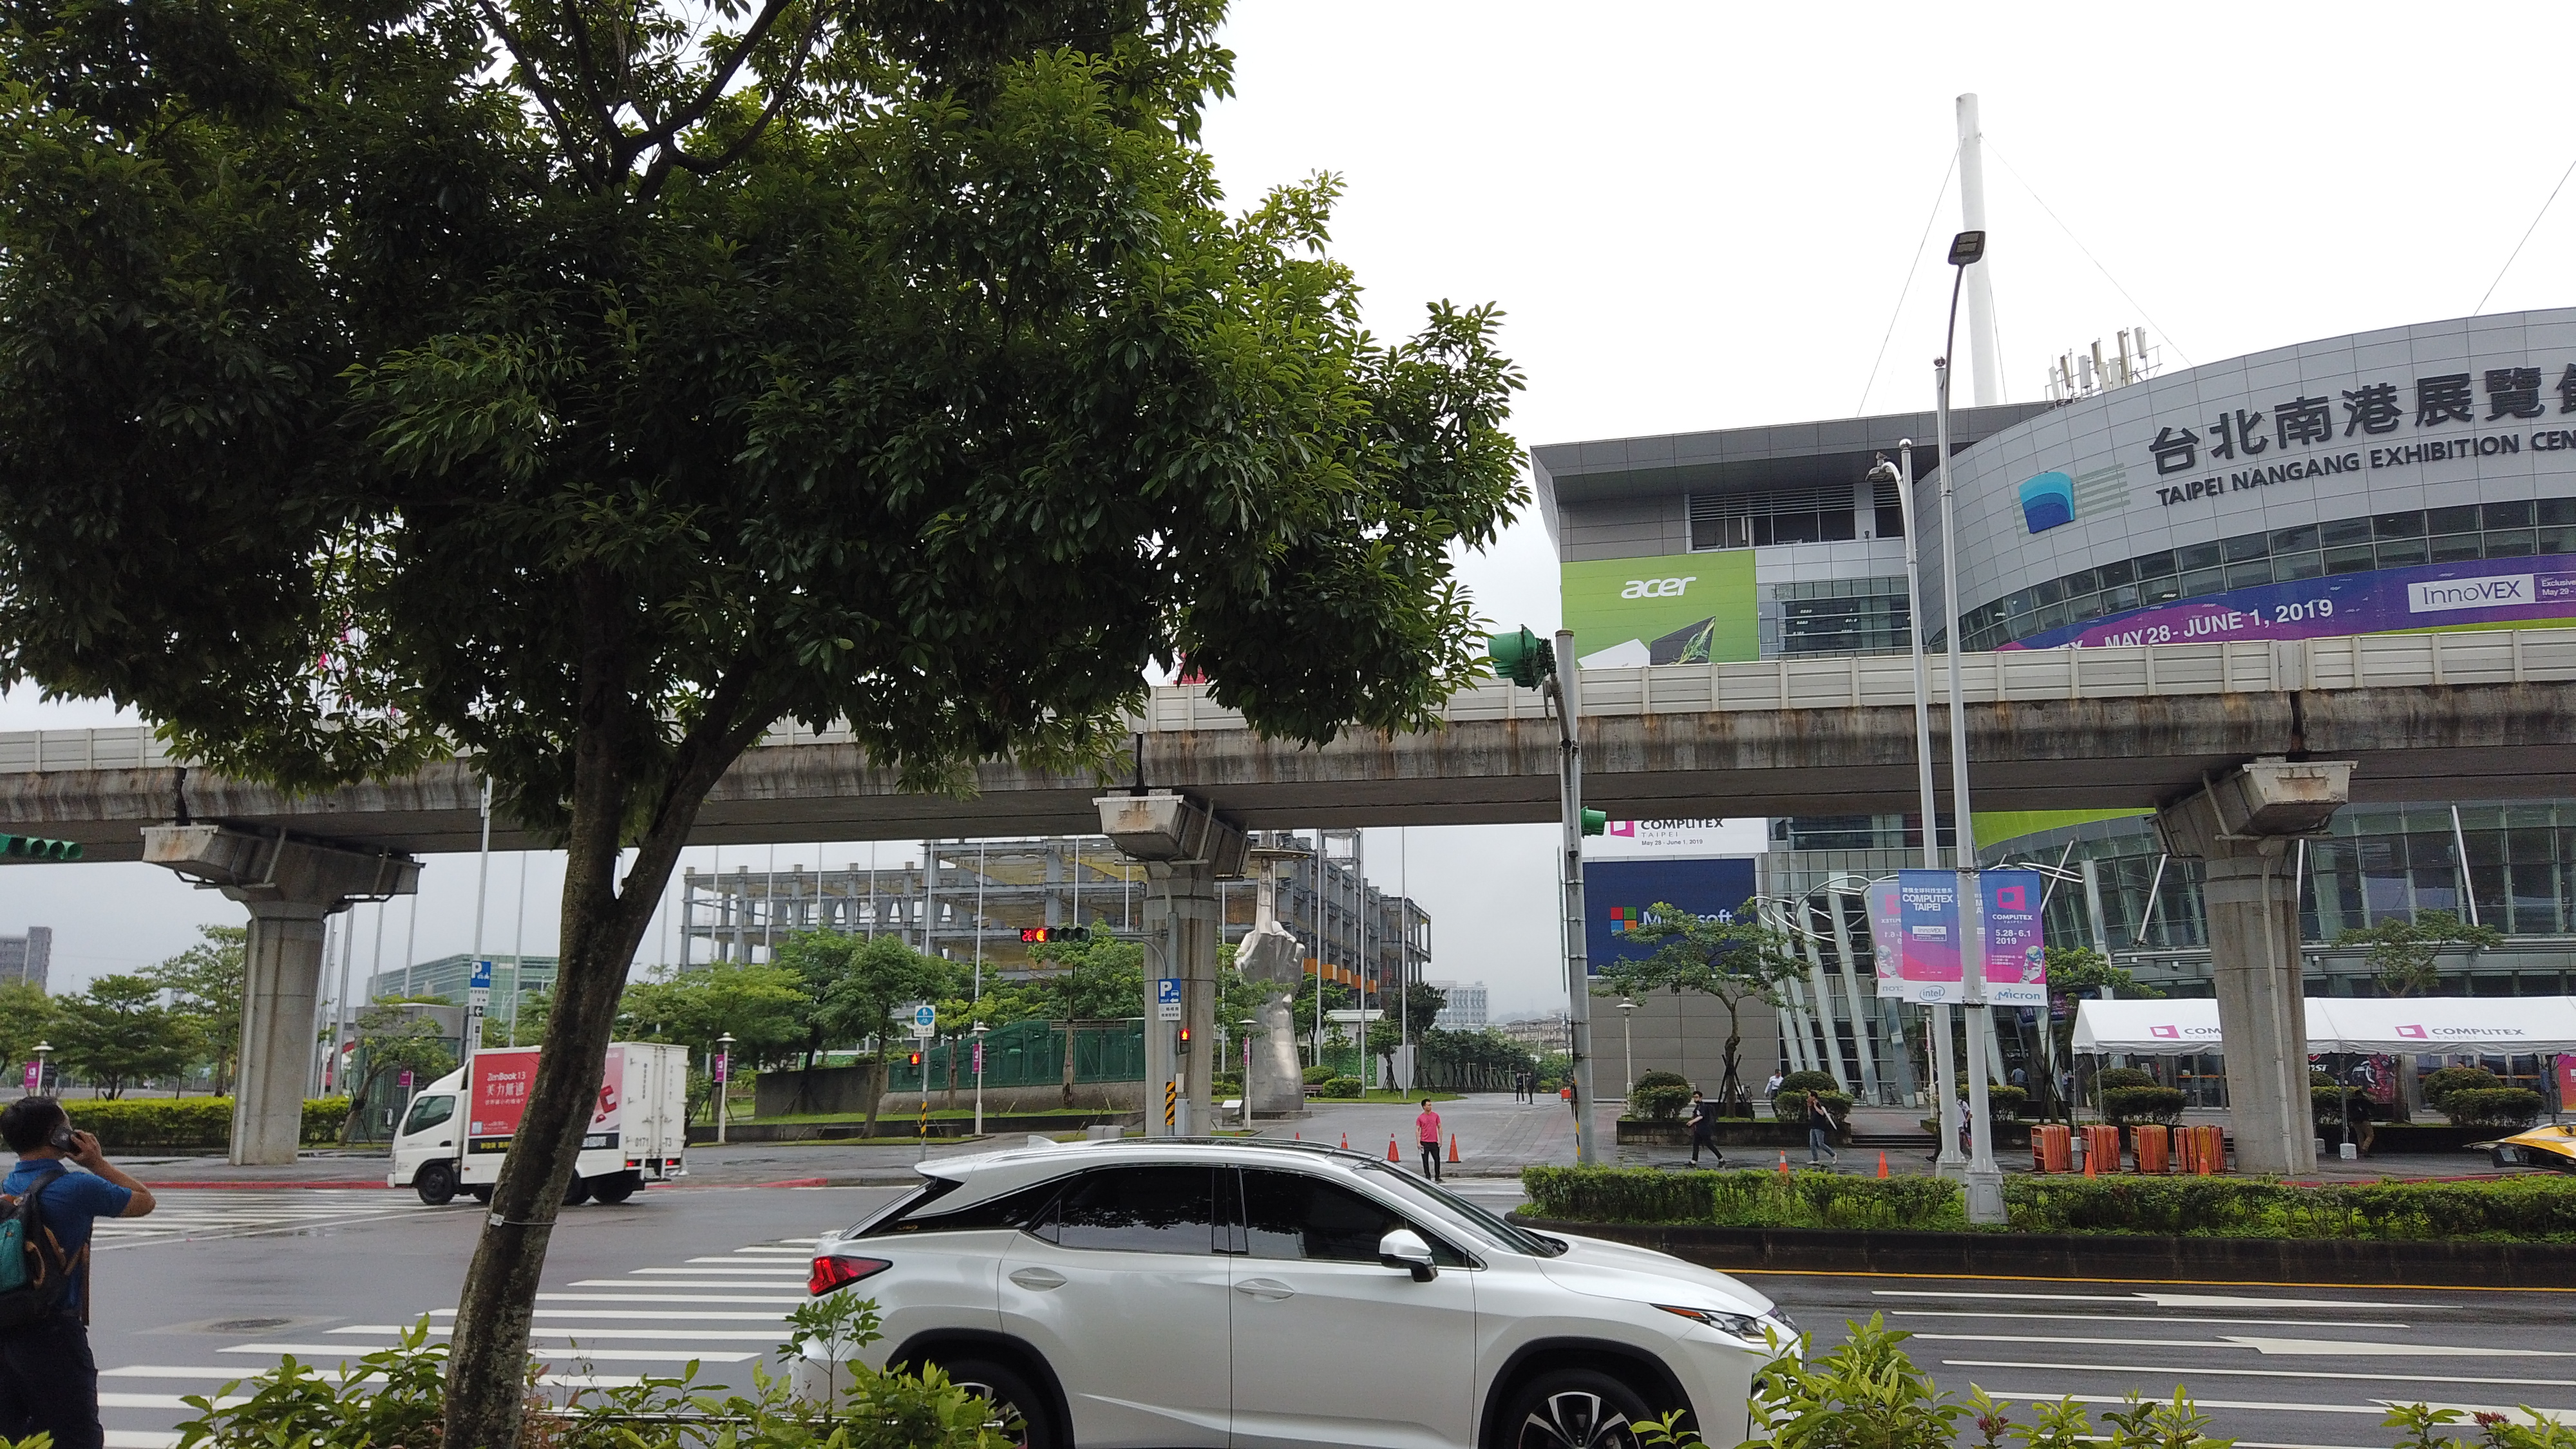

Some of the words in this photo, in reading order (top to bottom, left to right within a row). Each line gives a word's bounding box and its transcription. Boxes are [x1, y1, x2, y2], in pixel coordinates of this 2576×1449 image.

[2156, 477, 2224, 506] TAIPEI
[2233, 453, 2359, 491] NANGANG
[2371, 433, 2520, 468] EXHIBITION
[1621, 576, 1697, 599] acer
[2421, 580, 2521, 606] InnoVEX
[2542, 589, 2558, 597] May
[2104, 629, 2143, 647] MAY
[2183, 611, 2244, 638] JUNE
[2275, 599, 2334, 623] 2019
[1640, 818, 1724, 830] COMPUTEX
[1902, 895, 1953, 903] COMPUTEX
[1913, 903, 1941, 911] TAIPEI
[471, 961, 482, 978] P
[1160, 981, 1172, 997] P
[1922, 989, 1941, 998] intel
[1995, 989, 2040, 1001] Micron
[487, 1072, 517, 1082] ZenBook
[517, 1071, 526, 1080] 13
